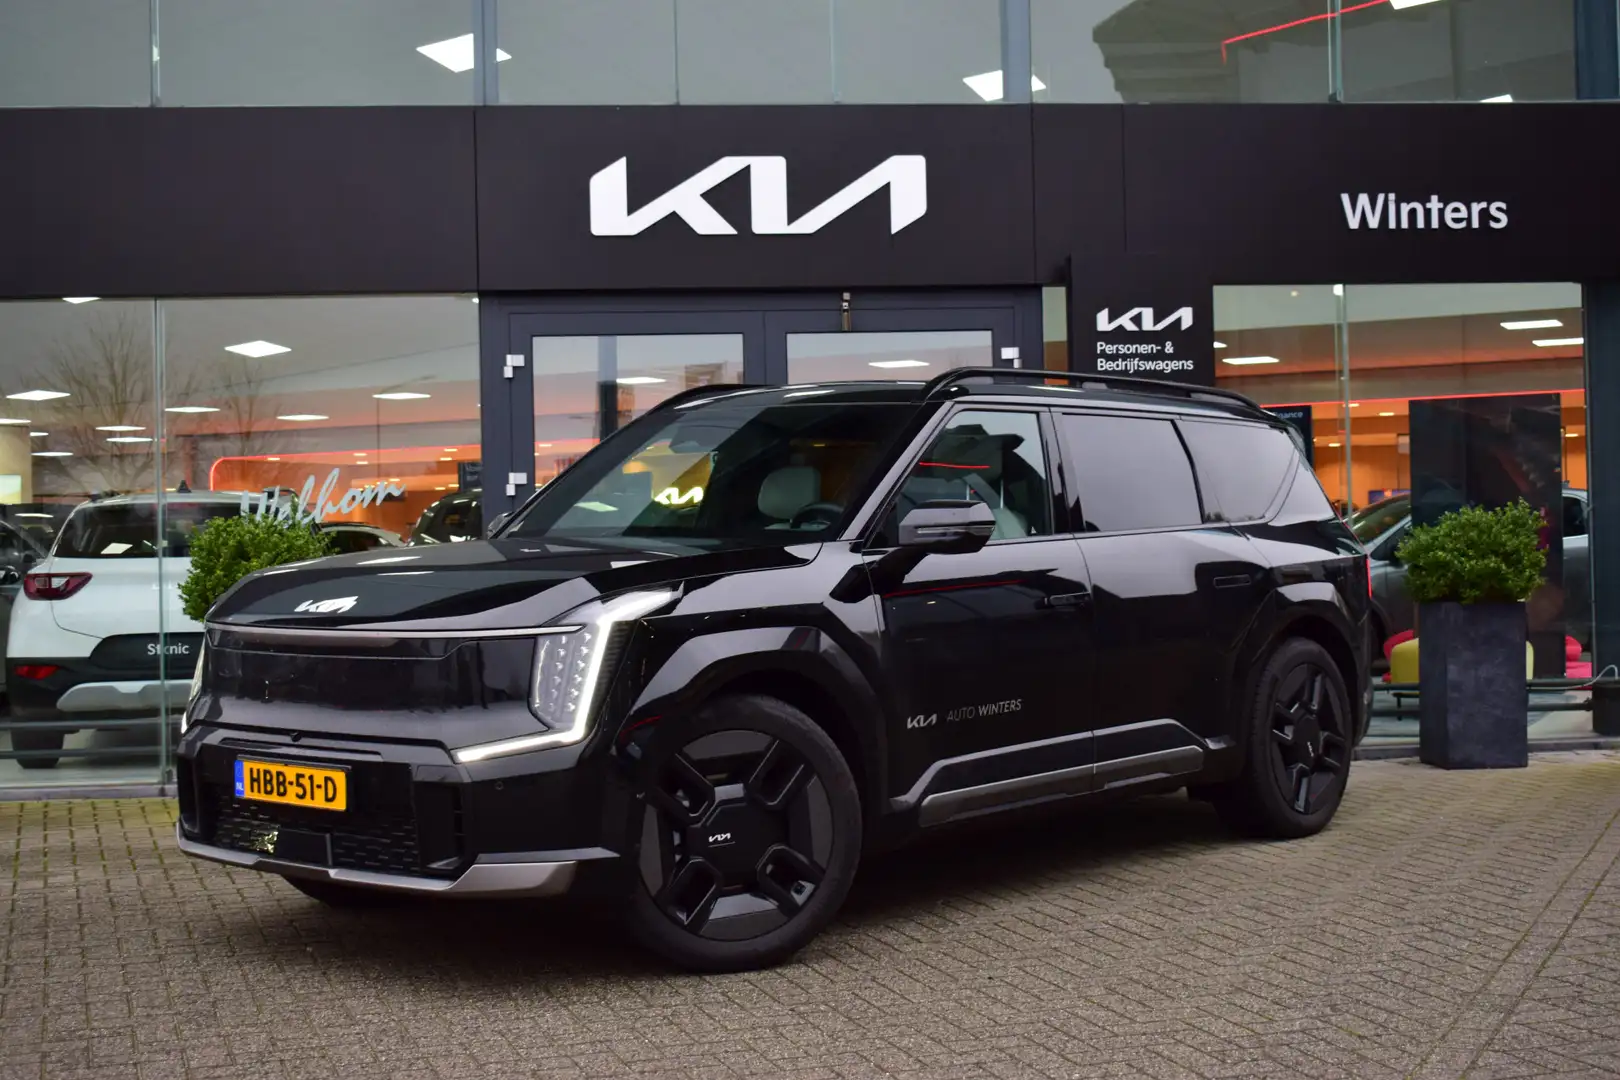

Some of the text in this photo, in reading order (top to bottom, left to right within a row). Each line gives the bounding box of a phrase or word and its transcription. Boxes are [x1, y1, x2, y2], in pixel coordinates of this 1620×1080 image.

[589, 155, 928, 236] KIA
[1340, 192, 1509, 230] Winters
[1096, 306, 1194, 332] KIA
[1096, 340, 1174, 354] Personen- &
[1097, 358, 1194, 374] Bedrijfswagens
[946, 706, 976, 722] AUTO
[978, 699, 1022, 716] WINTERS
[249, 767, 338, 803] HBB-51-D
